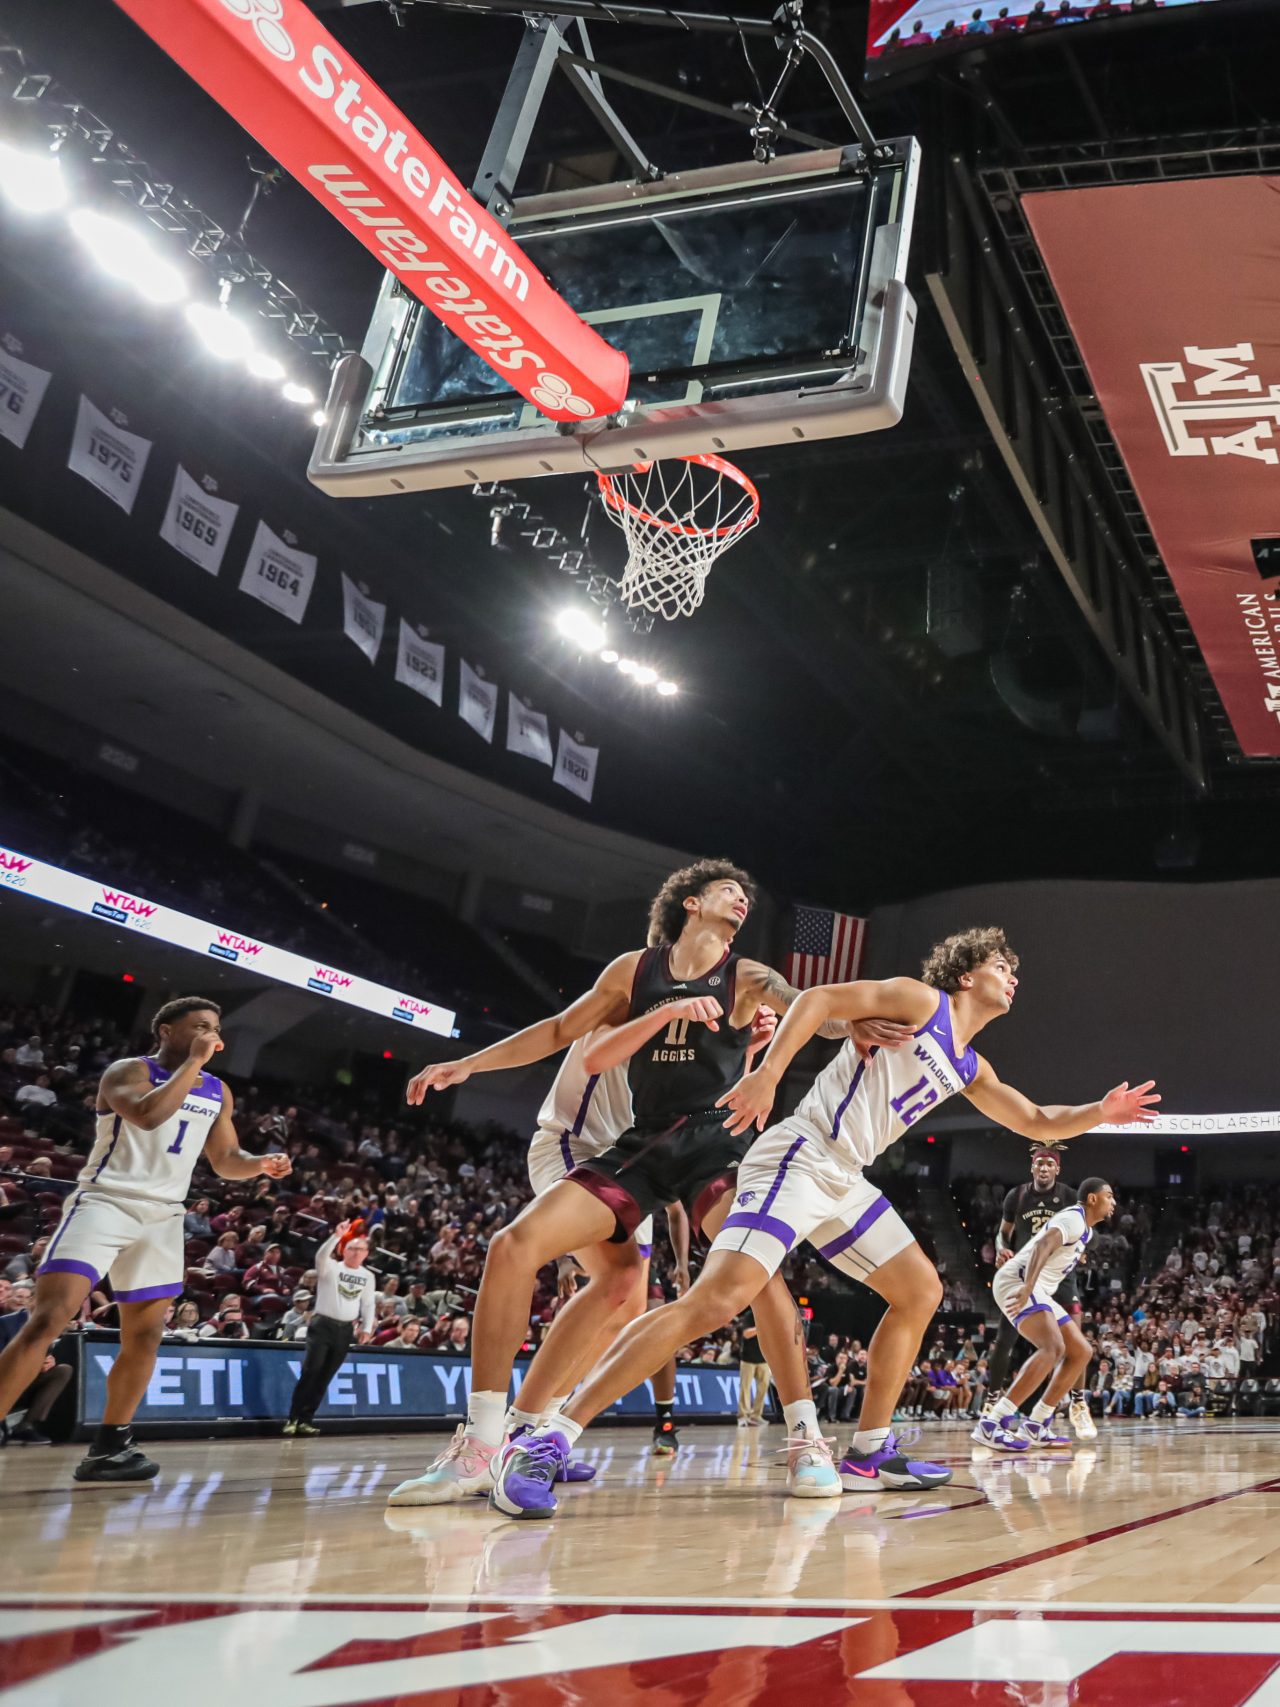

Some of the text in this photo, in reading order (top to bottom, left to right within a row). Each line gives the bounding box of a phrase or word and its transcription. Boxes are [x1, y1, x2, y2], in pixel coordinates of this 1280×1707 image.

[87, 437, 136, 483] 1975
[175, 504, 219, 548] 1969
[257, 558, 300, 597] 1964
[102, 888, 158, 918] WTAW
[217, 929, 263, 956] WTAW
[314, 965, 353, 988] WTAW
[652, 1048, 696, 1062] AGGIES
[889, 1074, 939, 1127] 12
[166, 1119, 190, 1155] 1
